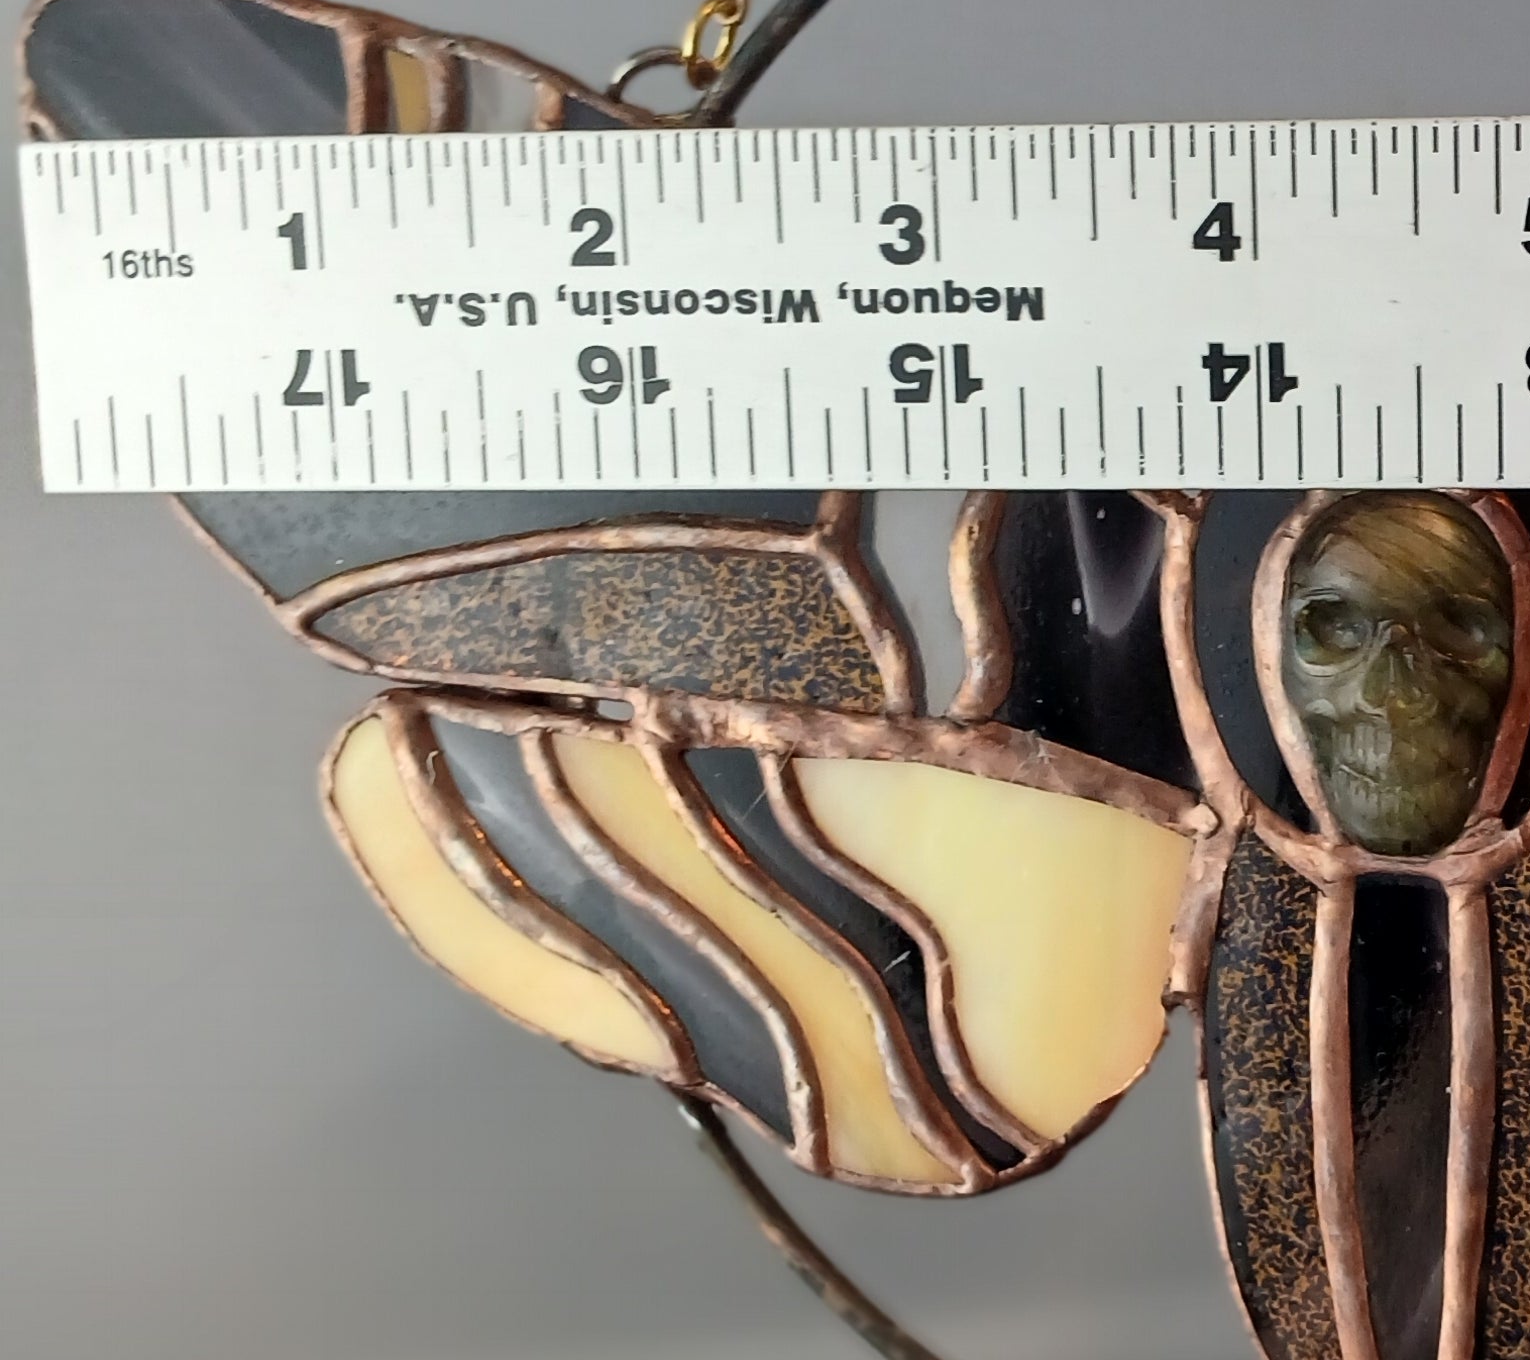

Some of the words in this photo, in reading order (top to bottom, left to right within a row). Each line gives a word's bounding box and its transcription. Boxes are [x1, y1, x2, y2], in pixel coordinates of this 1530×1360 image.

[278, 212, 307, 270] 1
[570, 208, 616, 266] 2
[879, 203, 925, 265] 3
[1192, 202, 1241, 262] 4
[102, 248, 194, 279] 16ths
[395, 291, 538, 327] U.S.A.
[556, 284, 820, 326] Wisconsin,
[837, 279, 1045, 322] Mequon,
[283, 349, 371, 407] 17
[577, 345, 671, 405] 16
[889, 343, 984, 404] 15
[1200, 342, 1299, 403] 14
